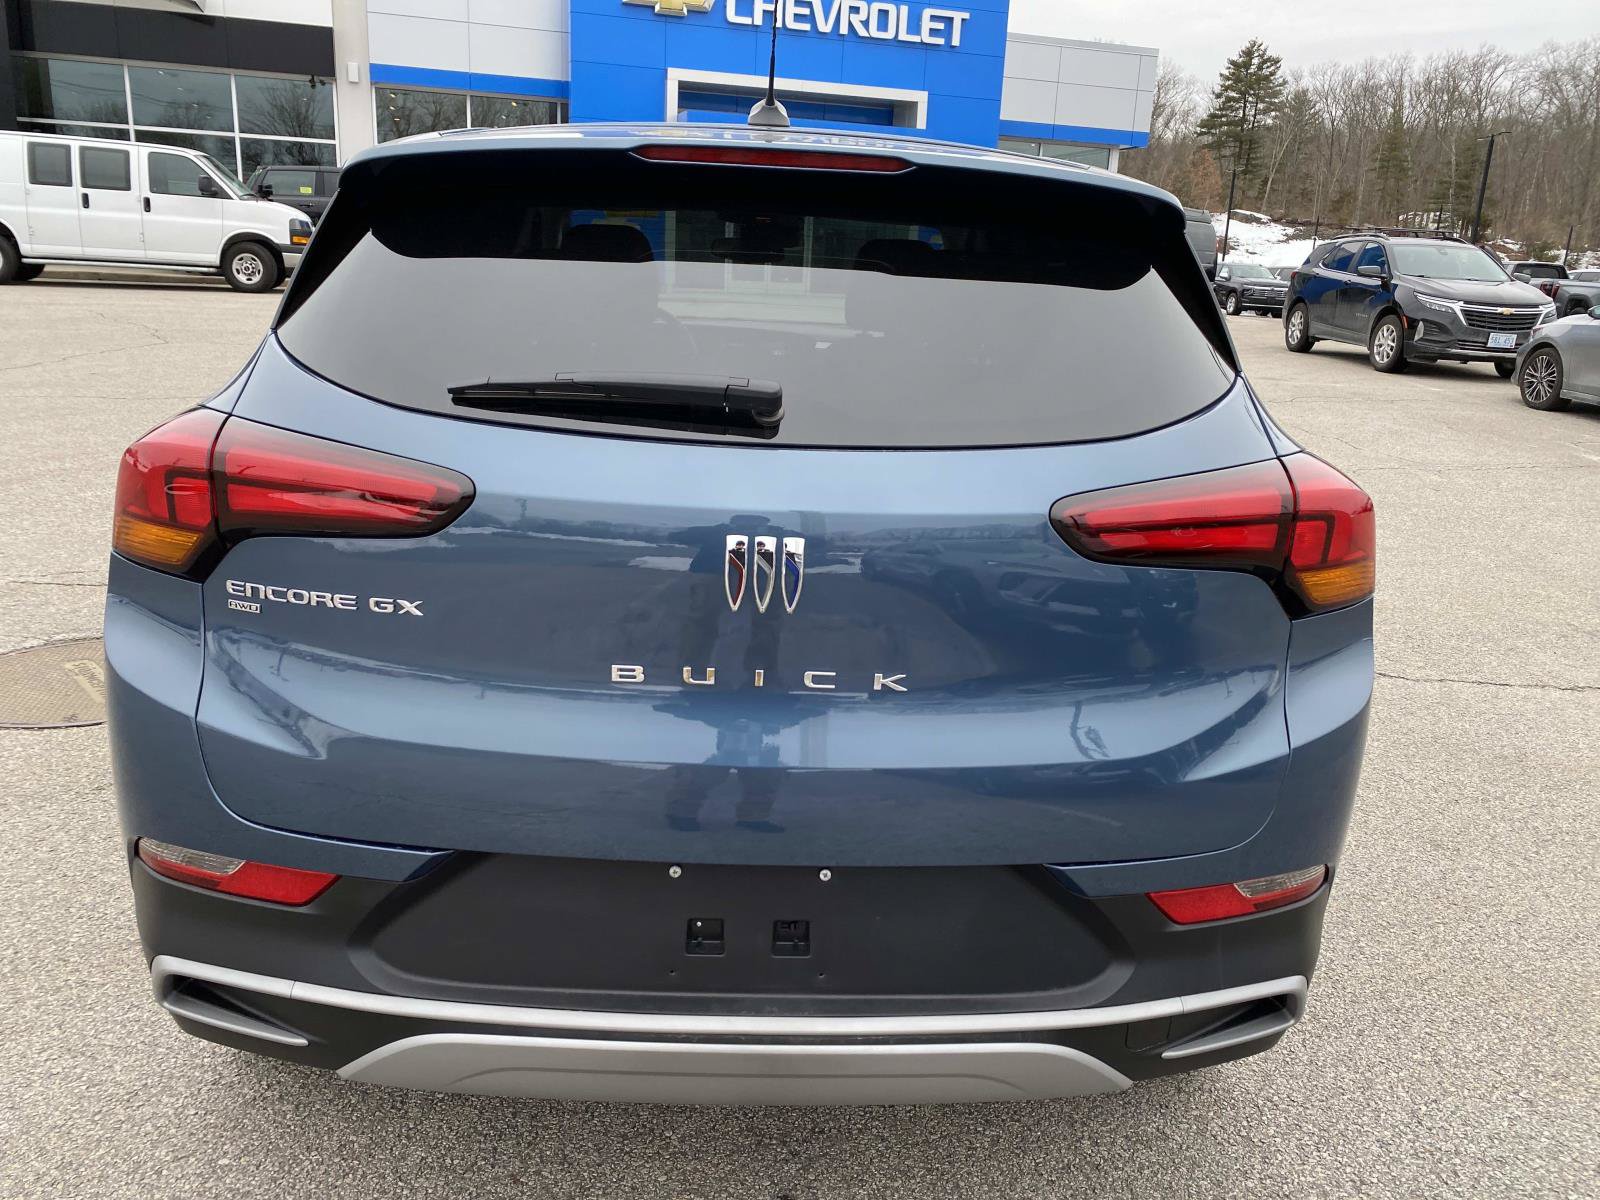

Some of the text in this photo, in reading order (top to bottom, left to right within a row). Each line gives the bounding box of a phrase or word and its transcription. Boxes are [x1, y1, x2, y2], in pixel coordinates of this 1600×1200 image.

[725, 0, 970, 47] CHEVROLET
[226, 579, 424, 616] ENCORE GX
[228, 600, 259, 612] AWD
[611, 664, 908, 692] BUICK
